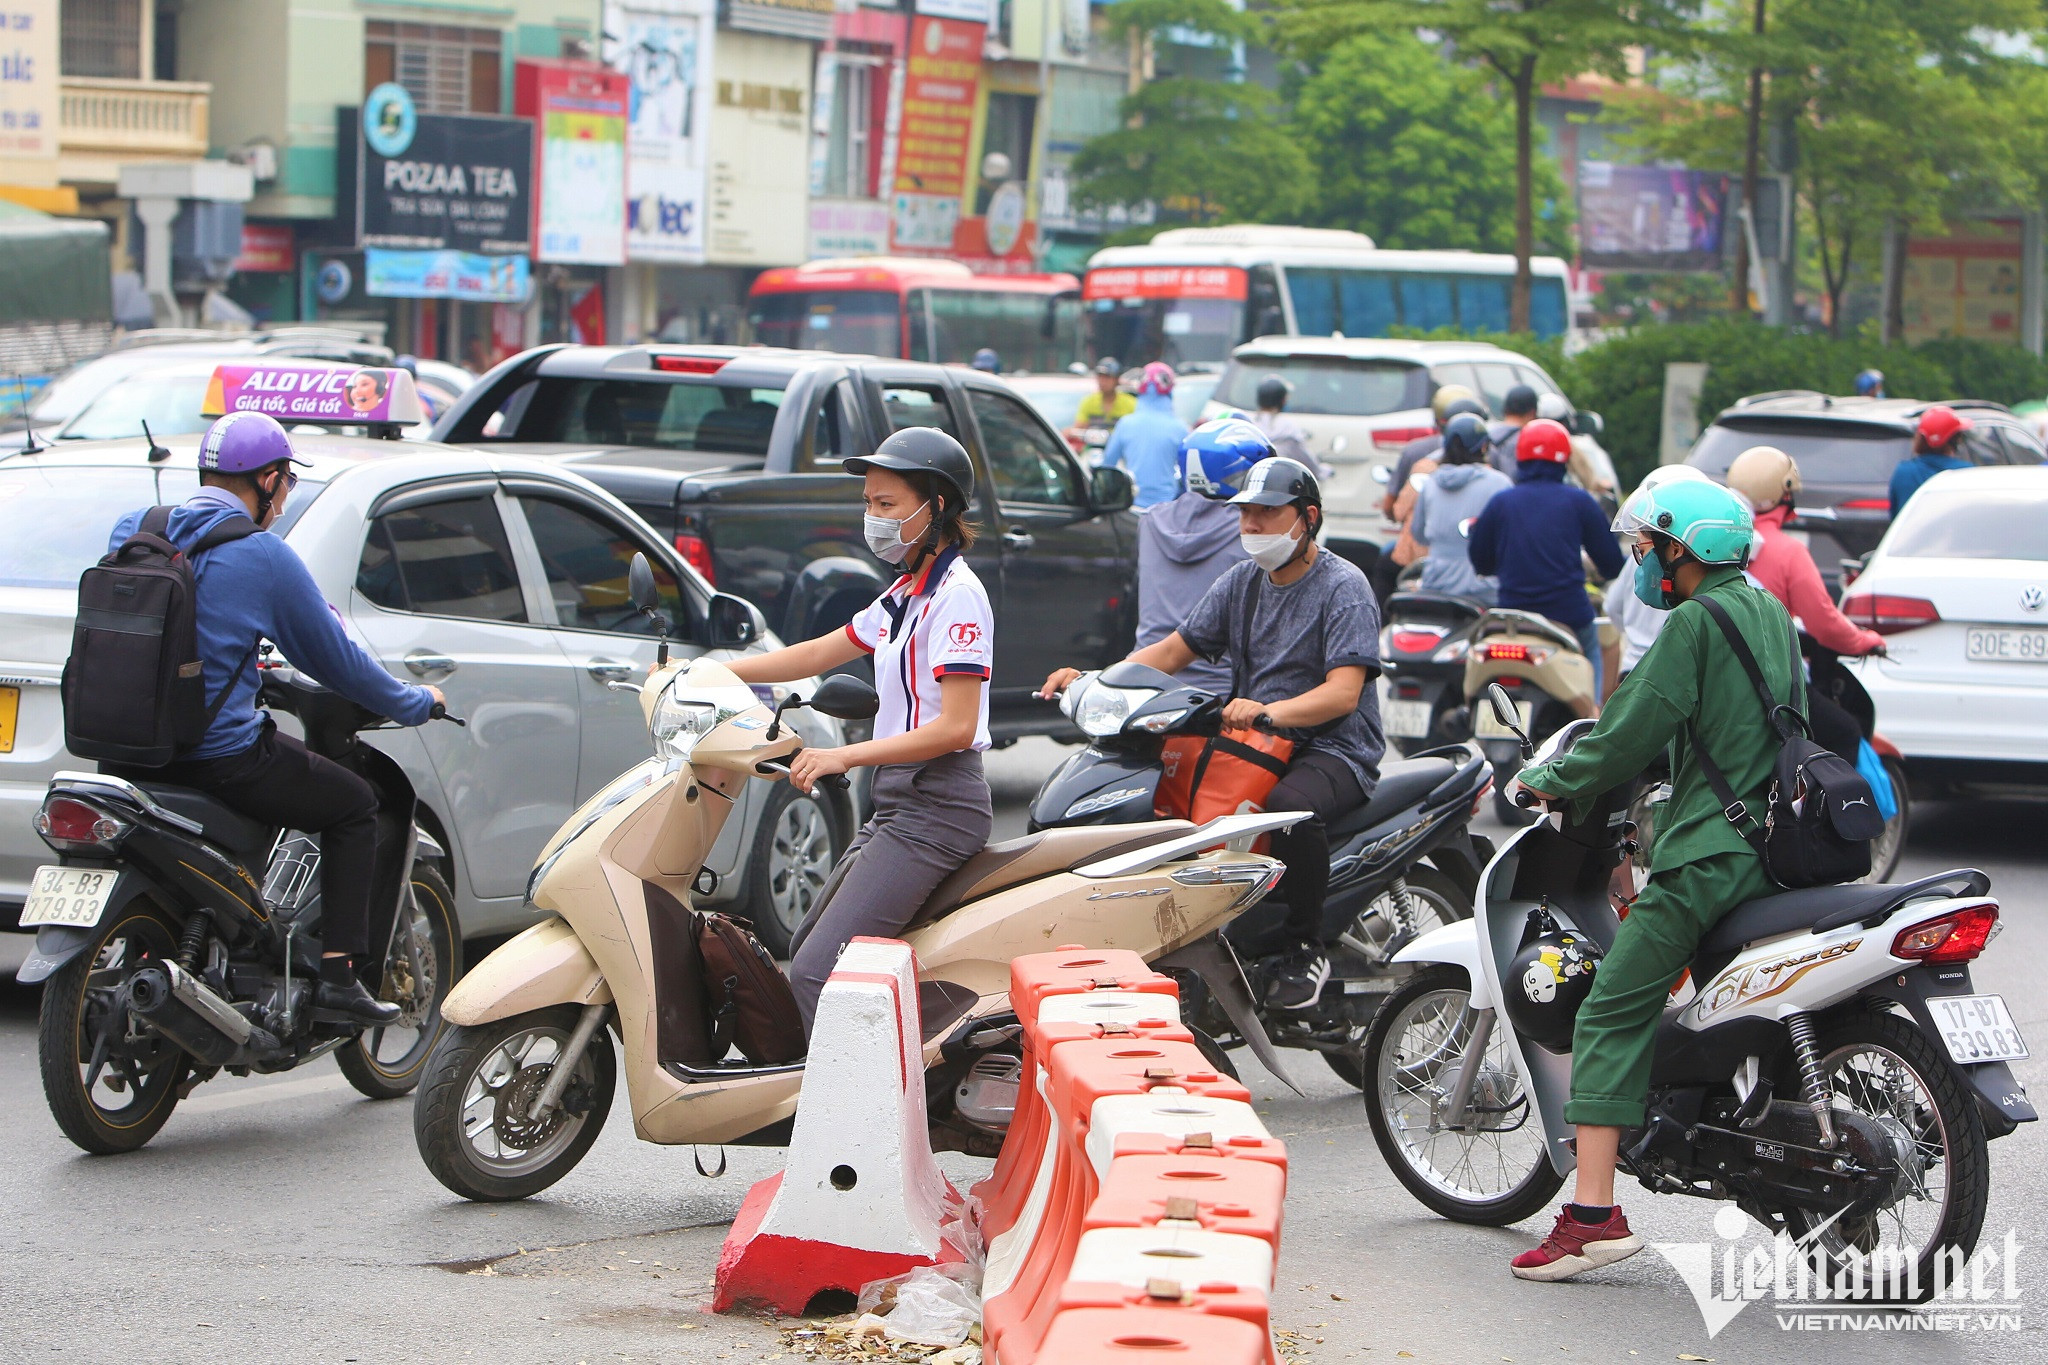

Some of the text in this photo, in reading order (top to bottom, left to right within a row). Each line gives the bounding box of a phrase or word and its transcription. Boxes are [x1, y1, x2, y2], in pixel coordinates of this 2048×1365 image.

[383, 160, 518, 197] POZAA TEA
[234, 394, 342, 415] Giá tốt, Giá tốt
[41, 870, 104, 896] 34-B3
[1086, 886, 1172, 901] LEAD
[24, 896, 100, 923] 779.93
[1938, 971, 1964, 980] HONDA
[1941, 999, 2000, 1029] 17-B7
[1945, 1027, 2025, 1059] 539.83
